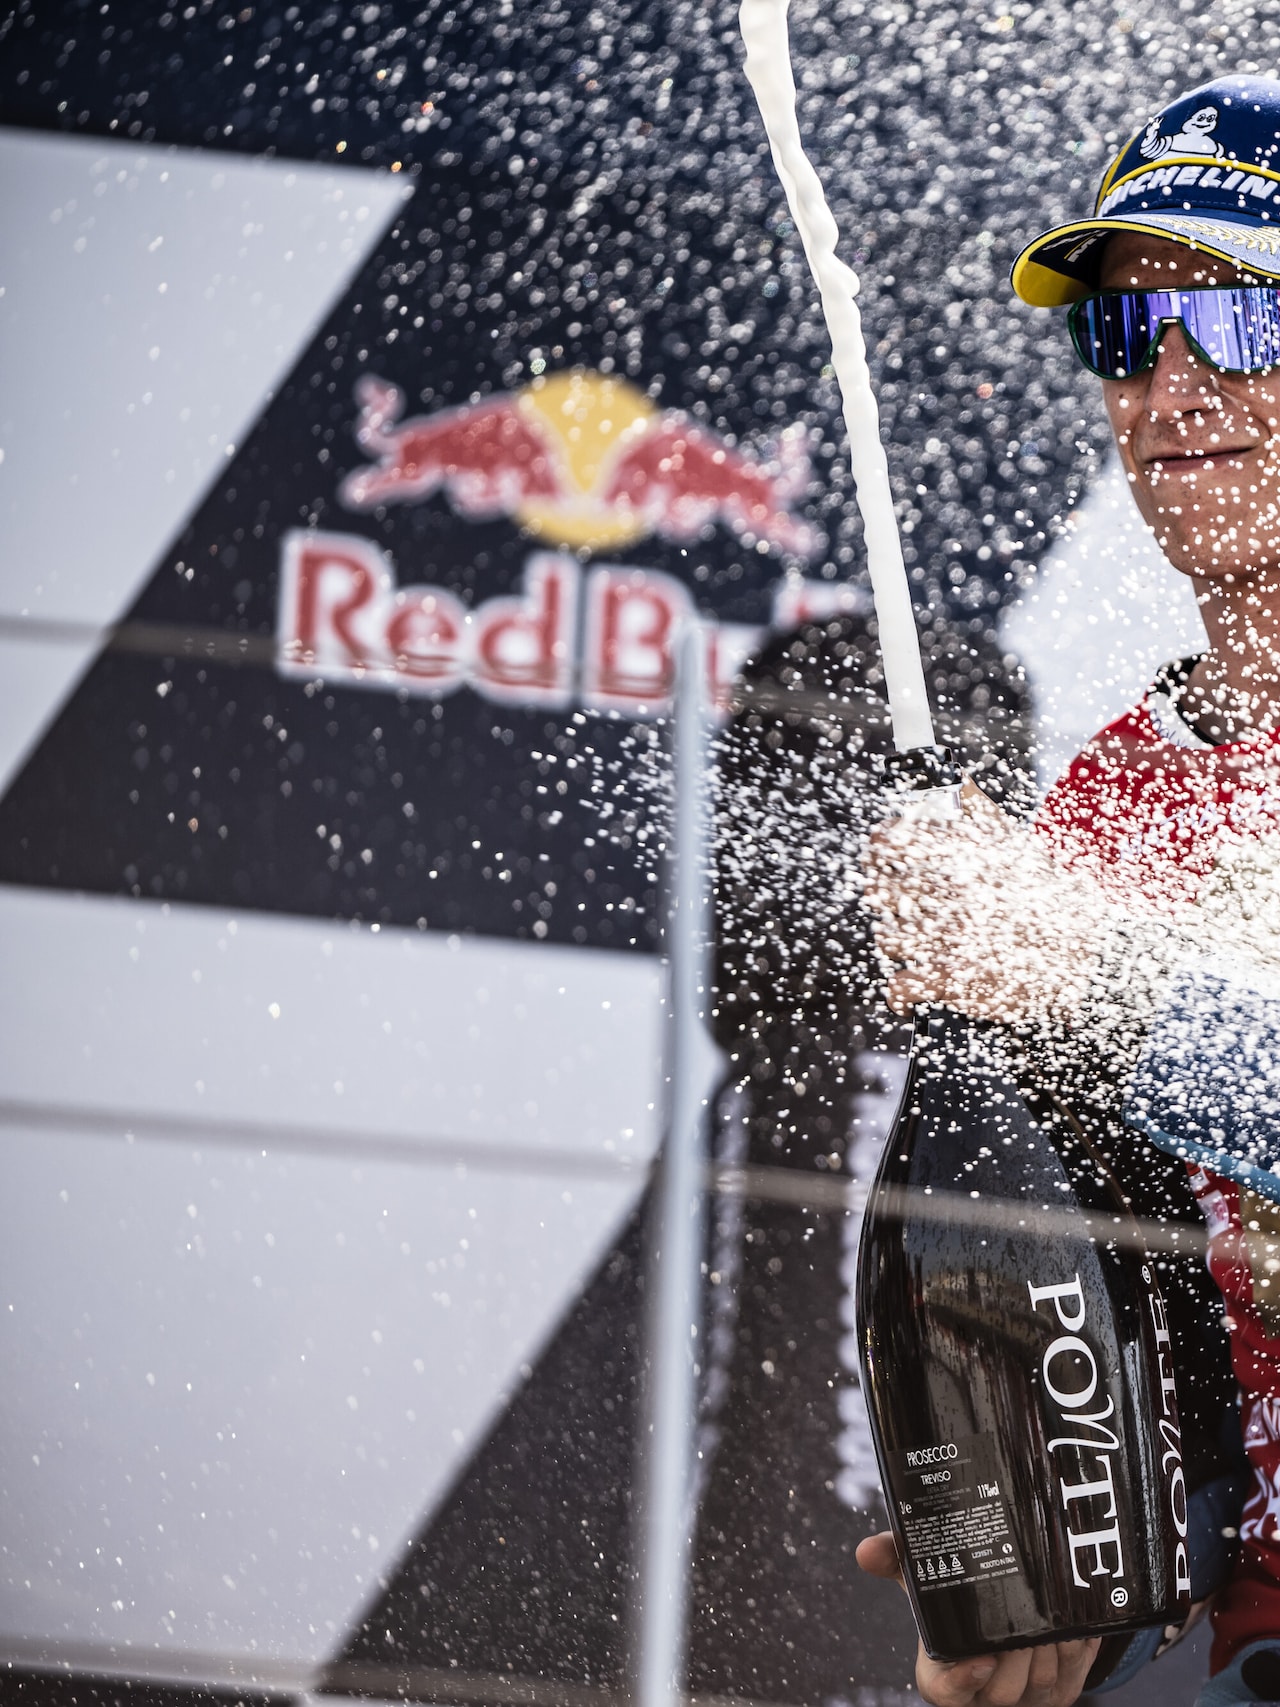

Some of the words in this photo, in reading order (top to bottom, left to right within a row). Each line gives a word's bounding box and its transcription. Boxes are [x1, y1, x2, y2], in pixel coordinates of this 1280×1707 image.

[281, 529, 580, 709] Red
[906, 1443, 958, 1468] PROSECCO
[920, 1470, 952, 1486] TREVISO
